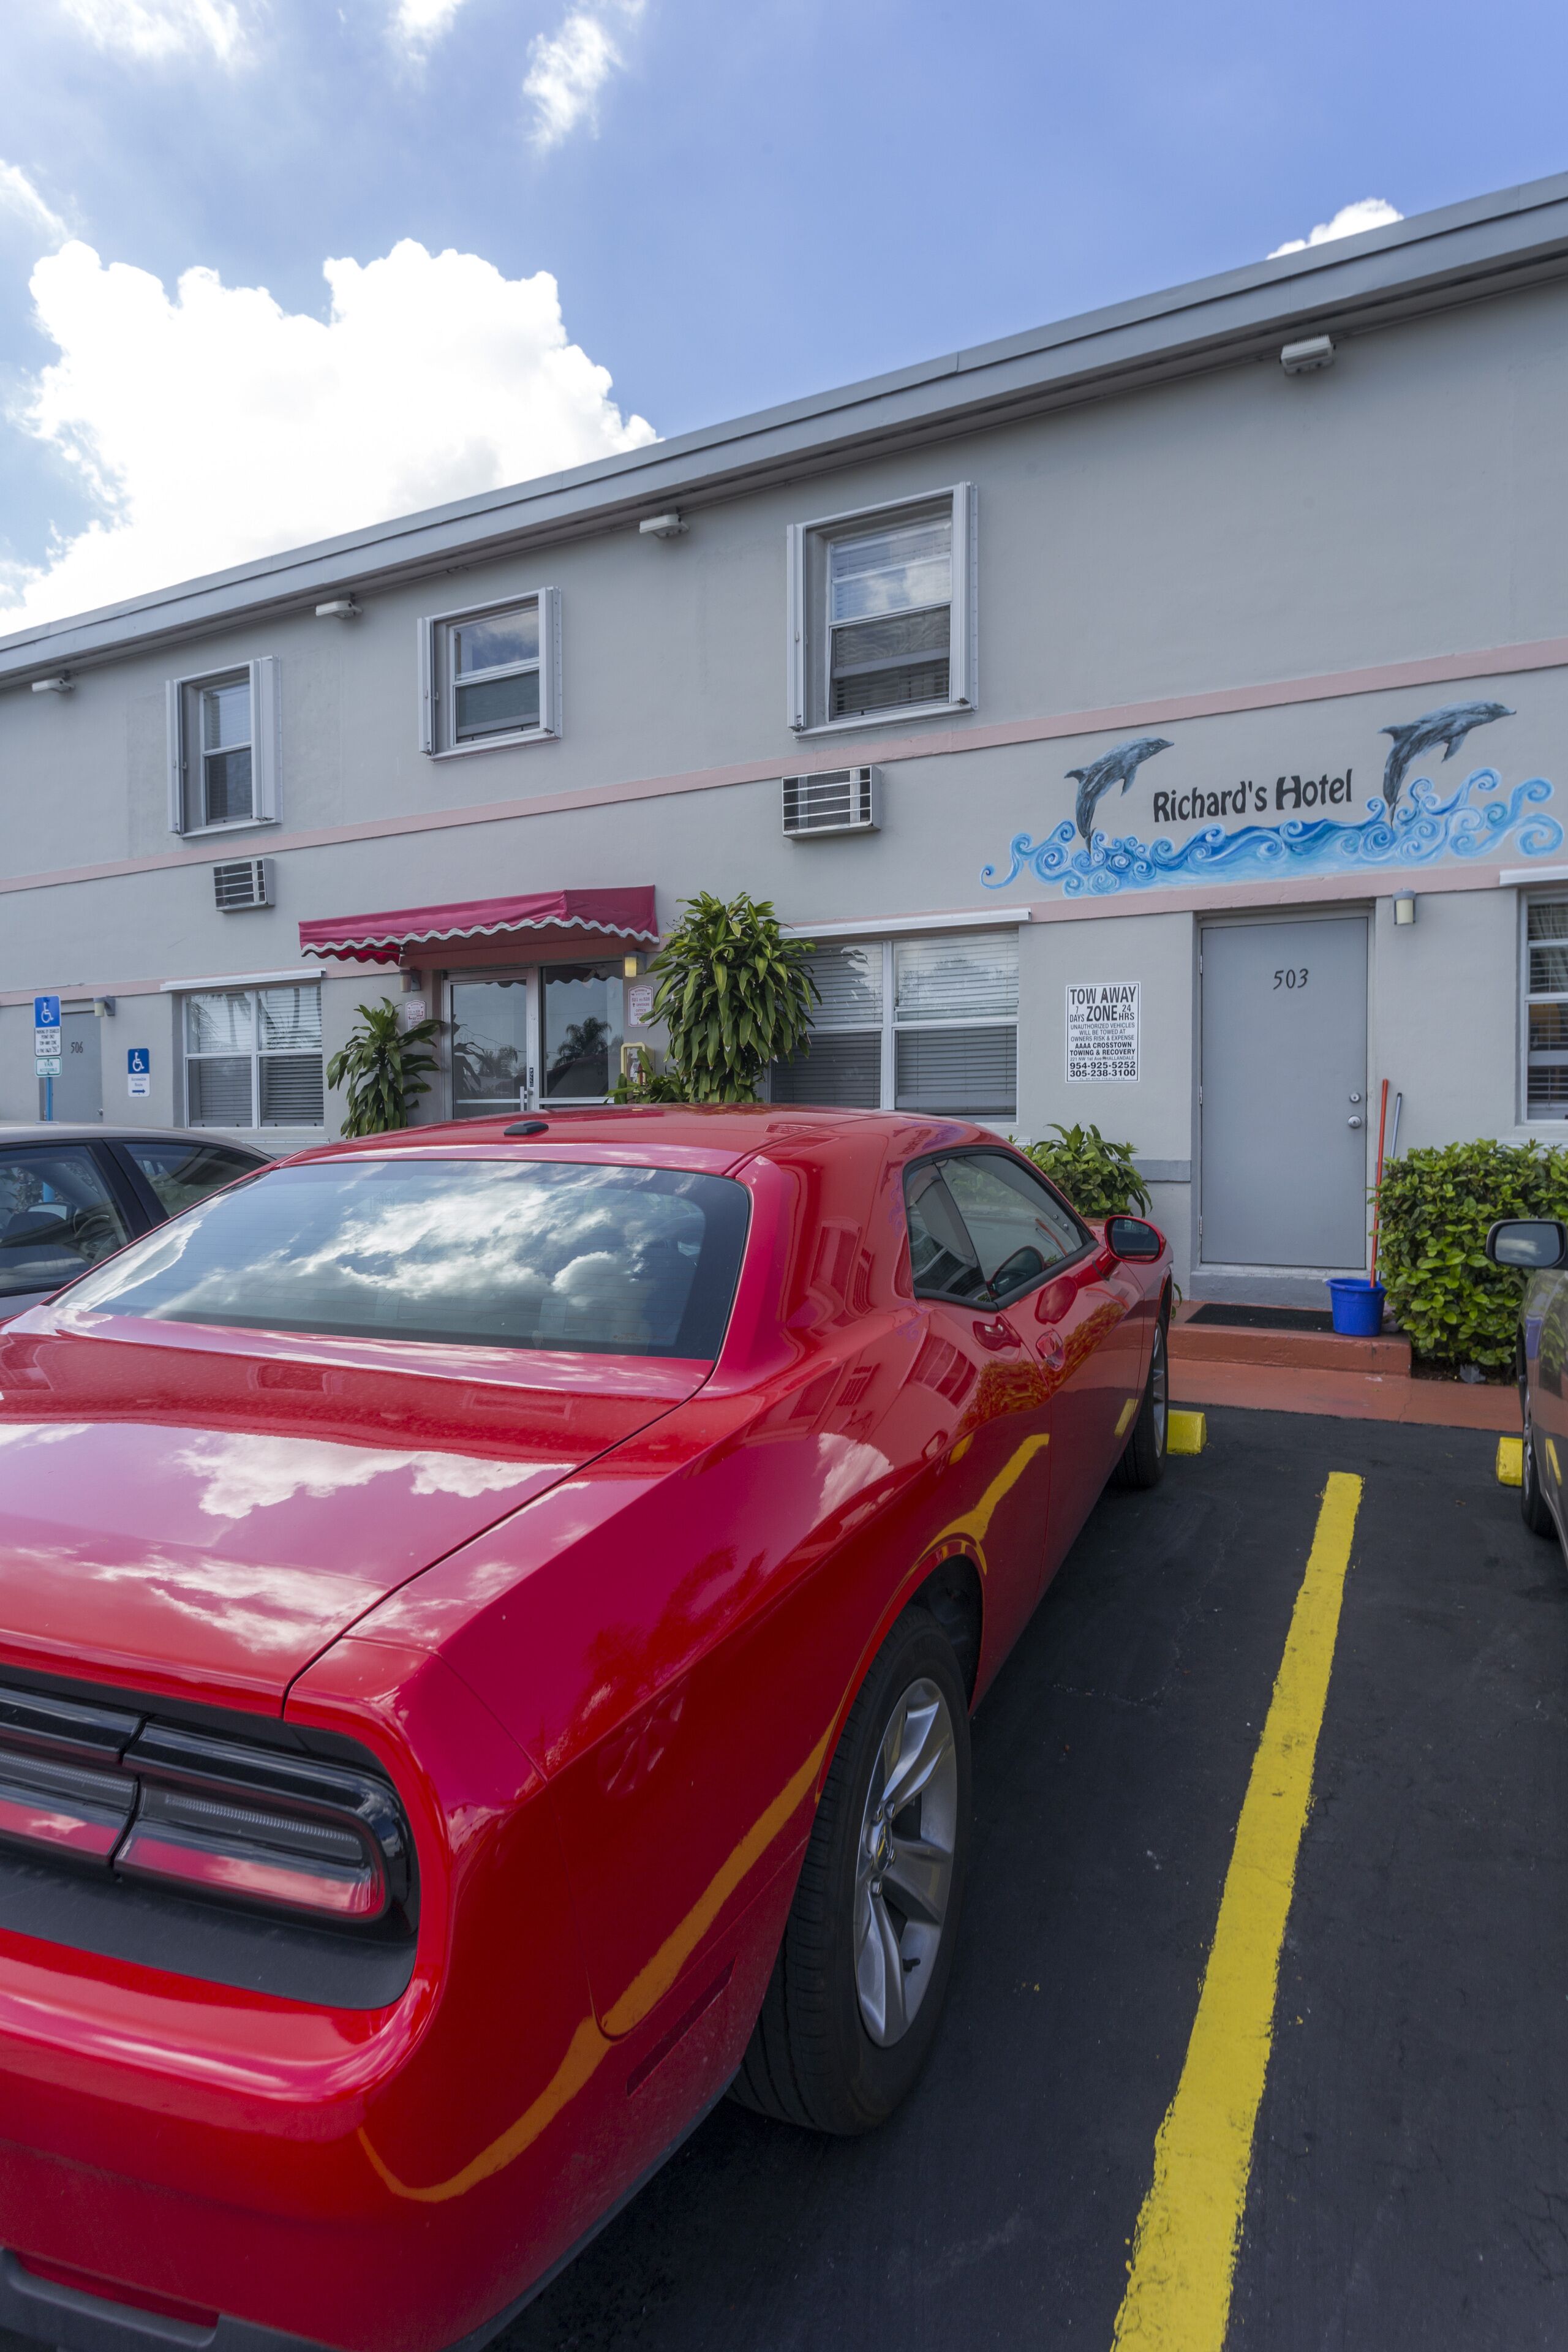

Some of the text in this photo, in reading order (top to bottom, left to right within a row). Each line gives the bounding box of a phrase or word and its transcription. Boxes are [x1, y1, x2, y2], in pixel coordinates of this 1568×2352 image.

[1153, 768, 1352, 823] Richard's Hotel
[1273, 968, 1309, 990] 503
[1070, 986, 1136, 1005] TOW AWAY
[1087, 1005, 1117, 1022] ZONE
[70, 1041, 83, 1054] 506
